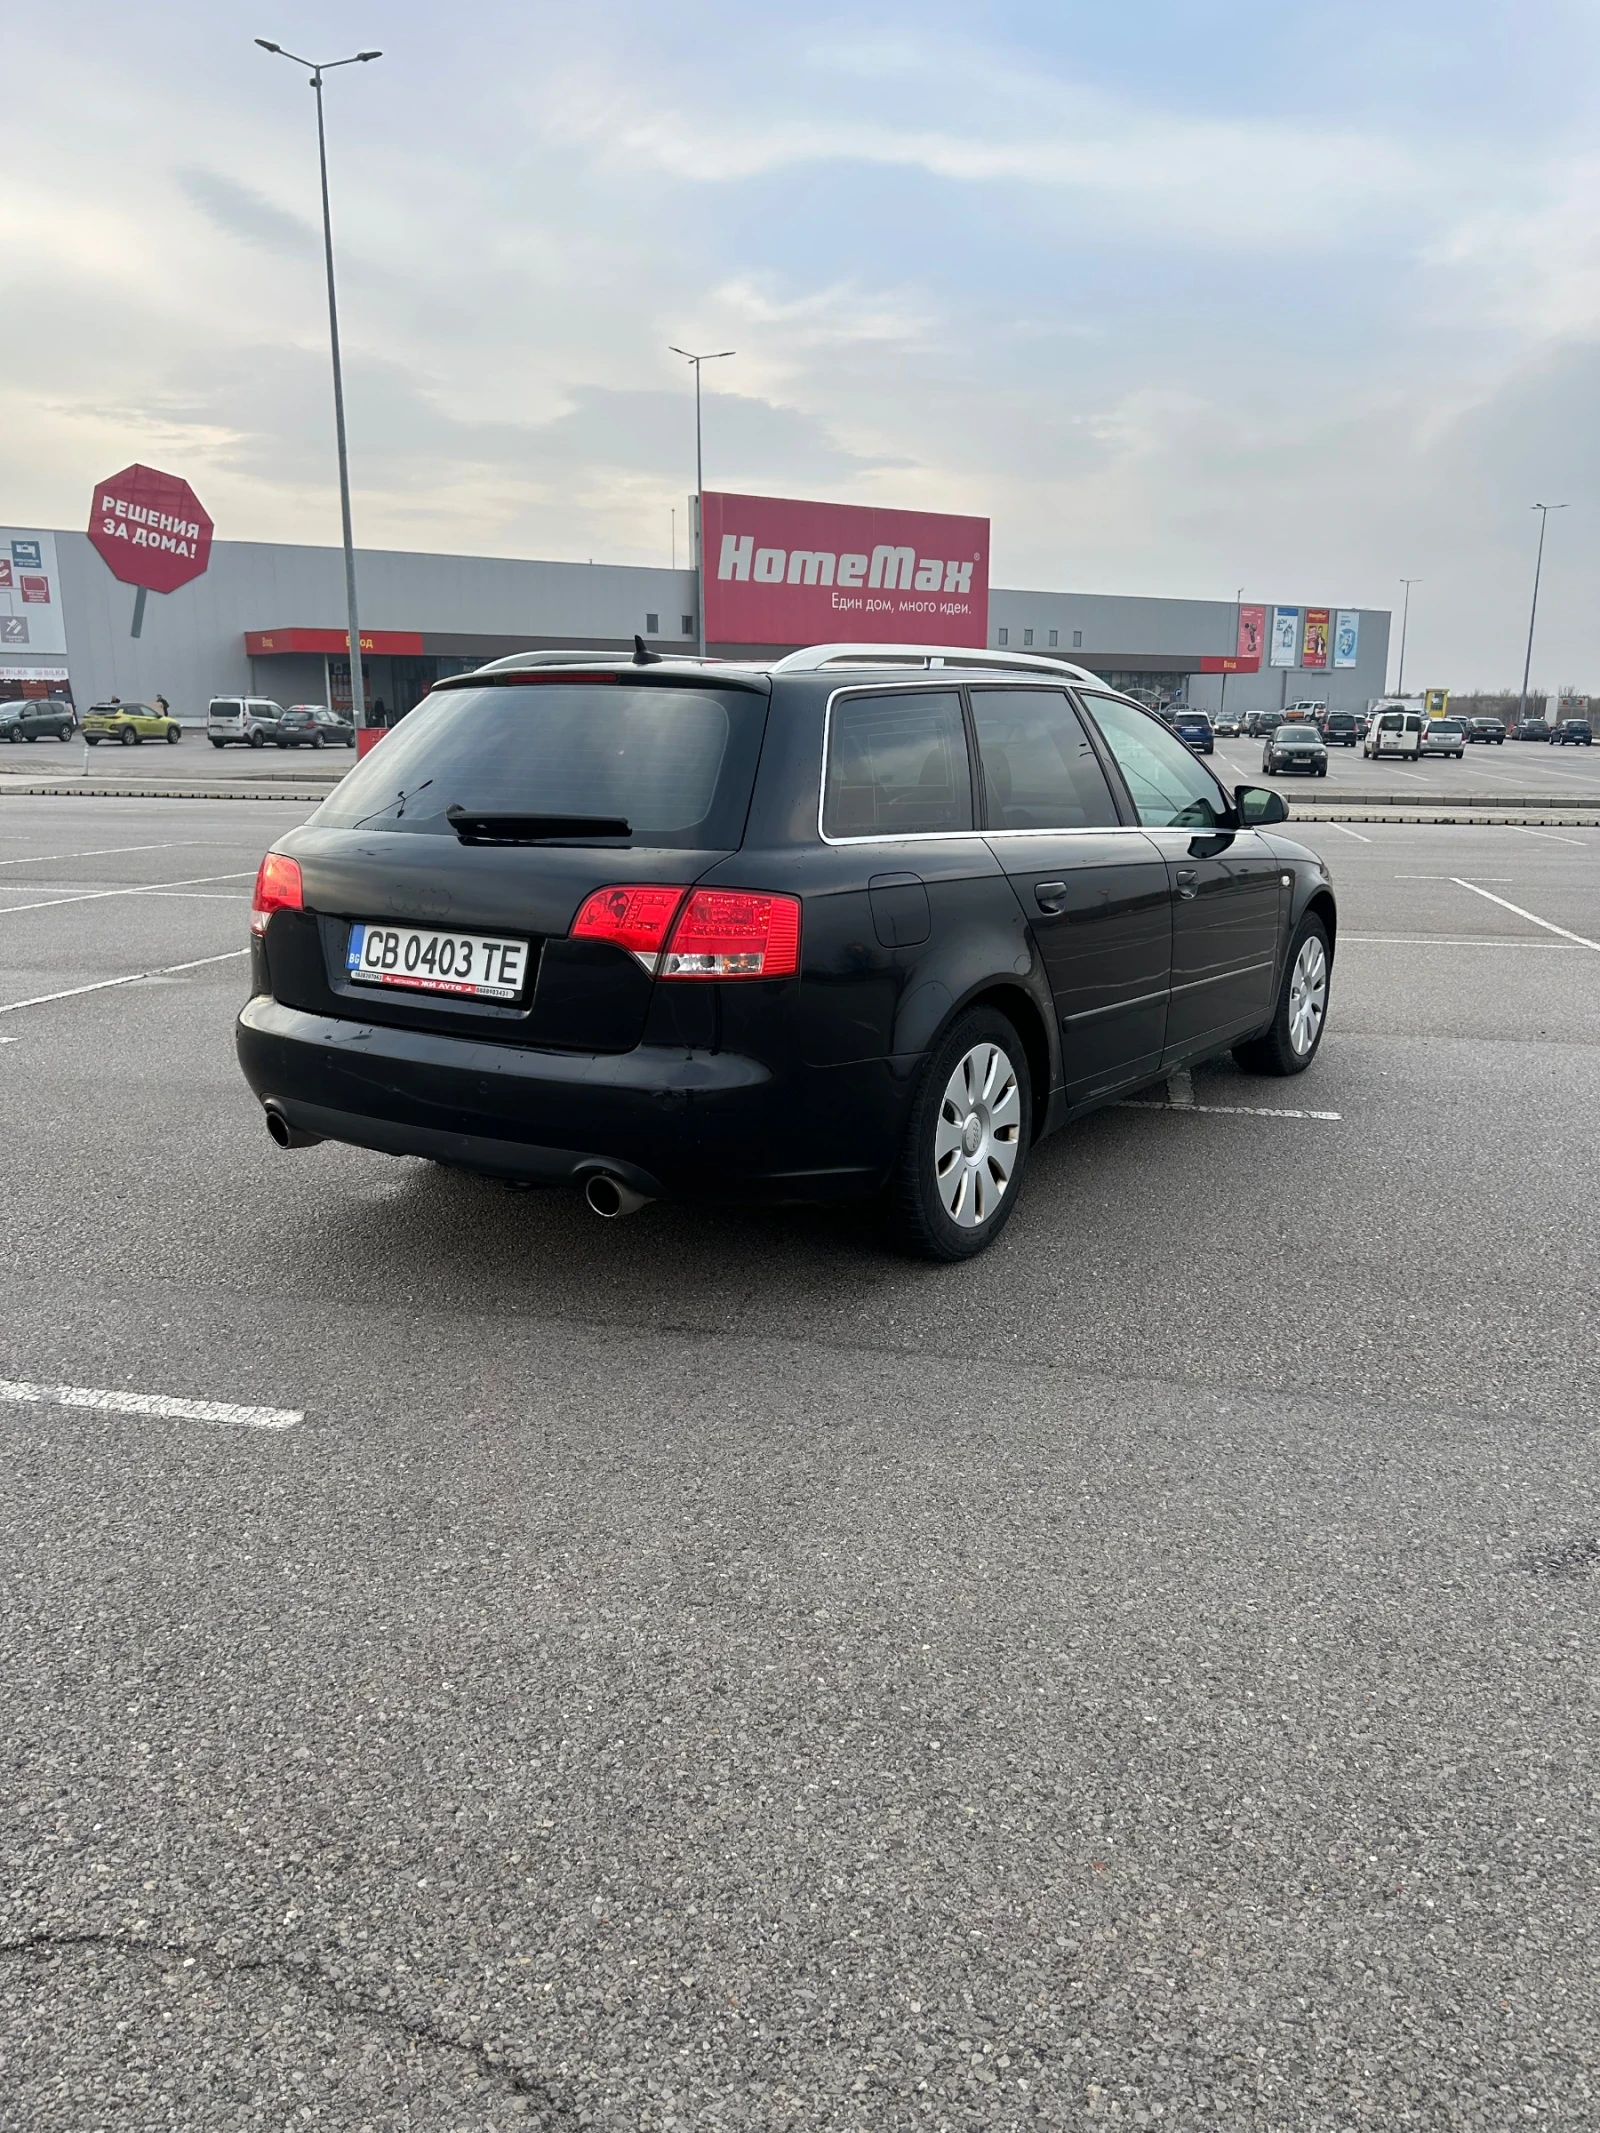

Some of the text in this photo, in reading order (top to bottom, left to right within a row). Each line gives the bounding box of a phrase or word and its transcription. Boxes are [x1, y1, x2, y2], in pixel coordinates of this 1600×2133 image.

[102, 495, 200, 540] РЕШЕНИЯ
[102, 518, 197, 559] ЗА ДОМА!
[717, 533, 974, 594] HomeMax
[831, 592, 972, 615] Един дом, много идеи.
[262, 637, 273, 648] Вход
[346, 636, 373, 649] Вод
[1223, 660, 1237, 669] Вход
[348, 952, 361, 964] BG
[404, 934, 473, 978] 0403
[938, 1021, 980, 1082] UNIROYAL
